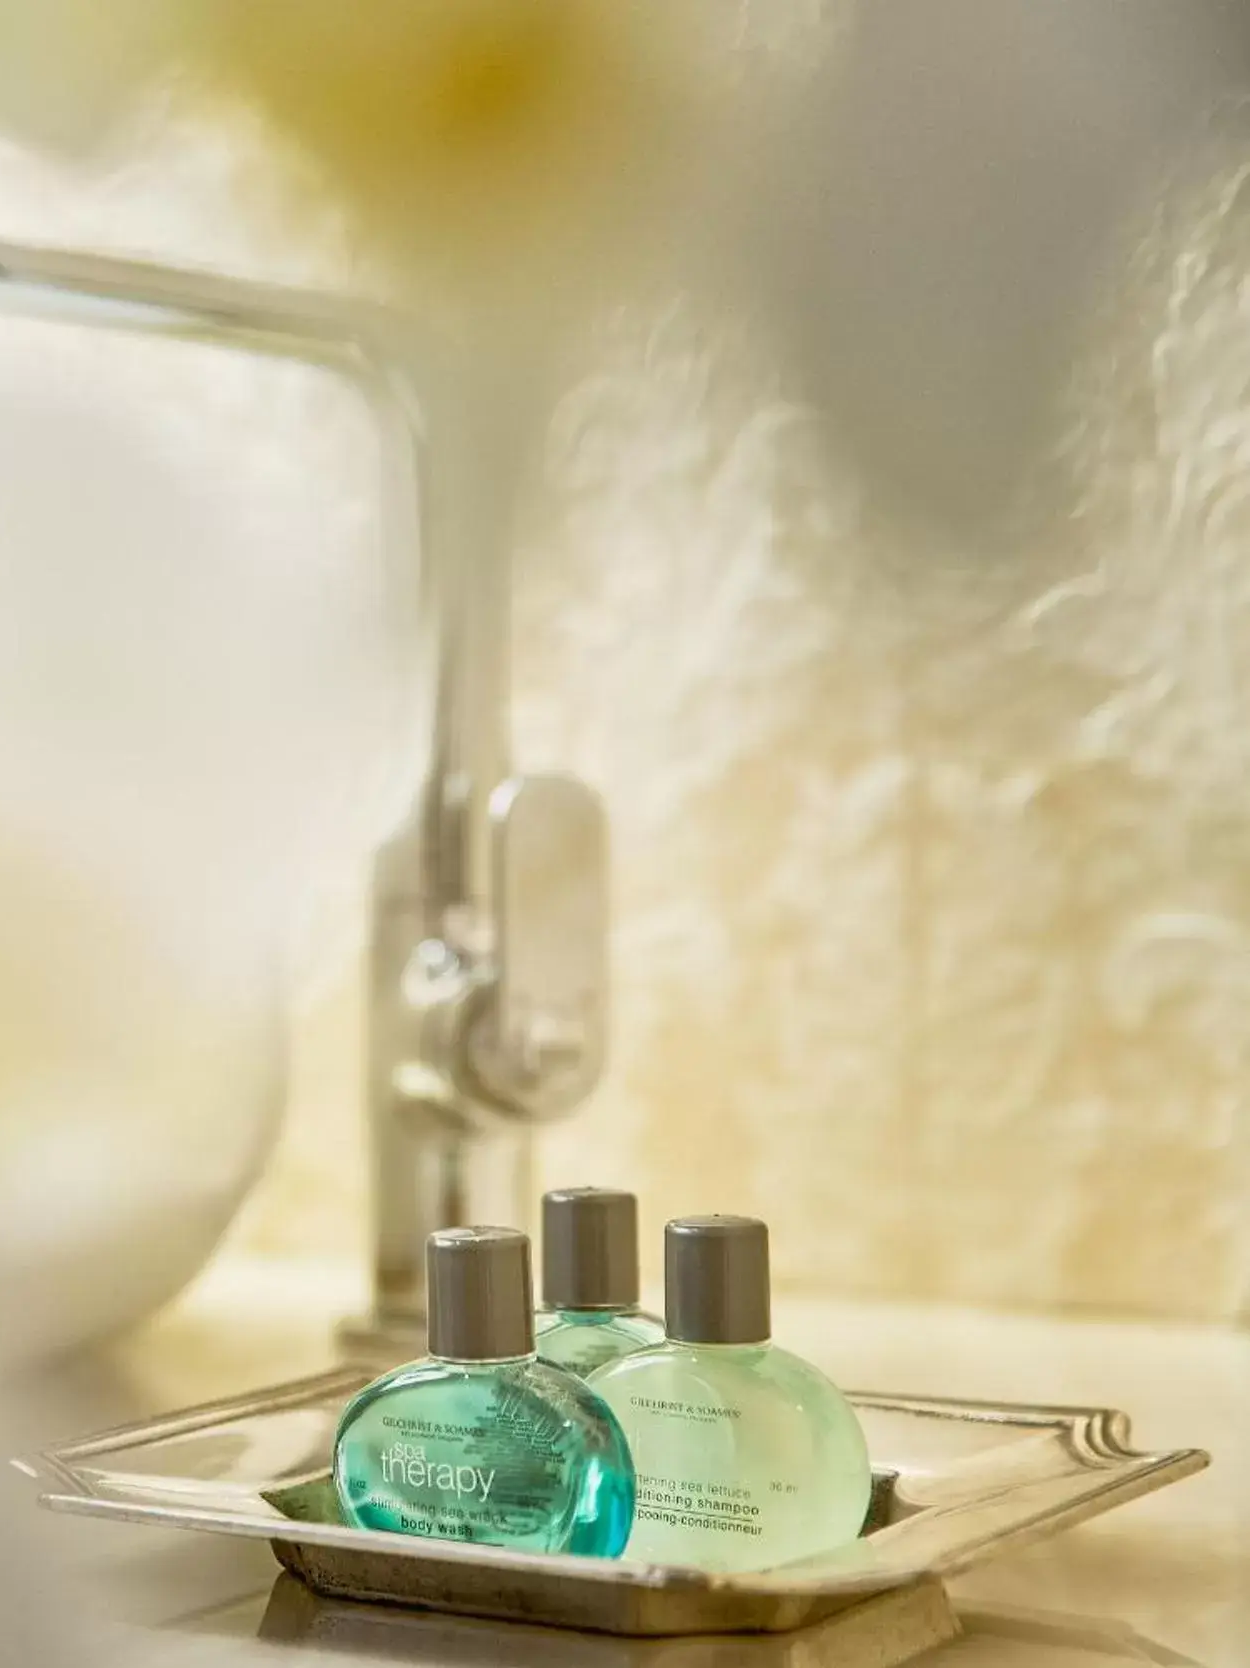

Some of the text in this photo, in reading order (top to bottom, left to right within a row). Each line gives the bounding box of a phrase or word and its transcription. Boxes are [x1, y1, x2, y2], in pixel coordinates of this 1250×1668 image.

[395, 1441, 427, 1462] spa
[381, 1448, 495, 1502] therapy
[708, 1482, 751, 1499] lettuce
[698, 1498, 759, 1516] shampoo
[401, 1515, 473, 1537] body wash
